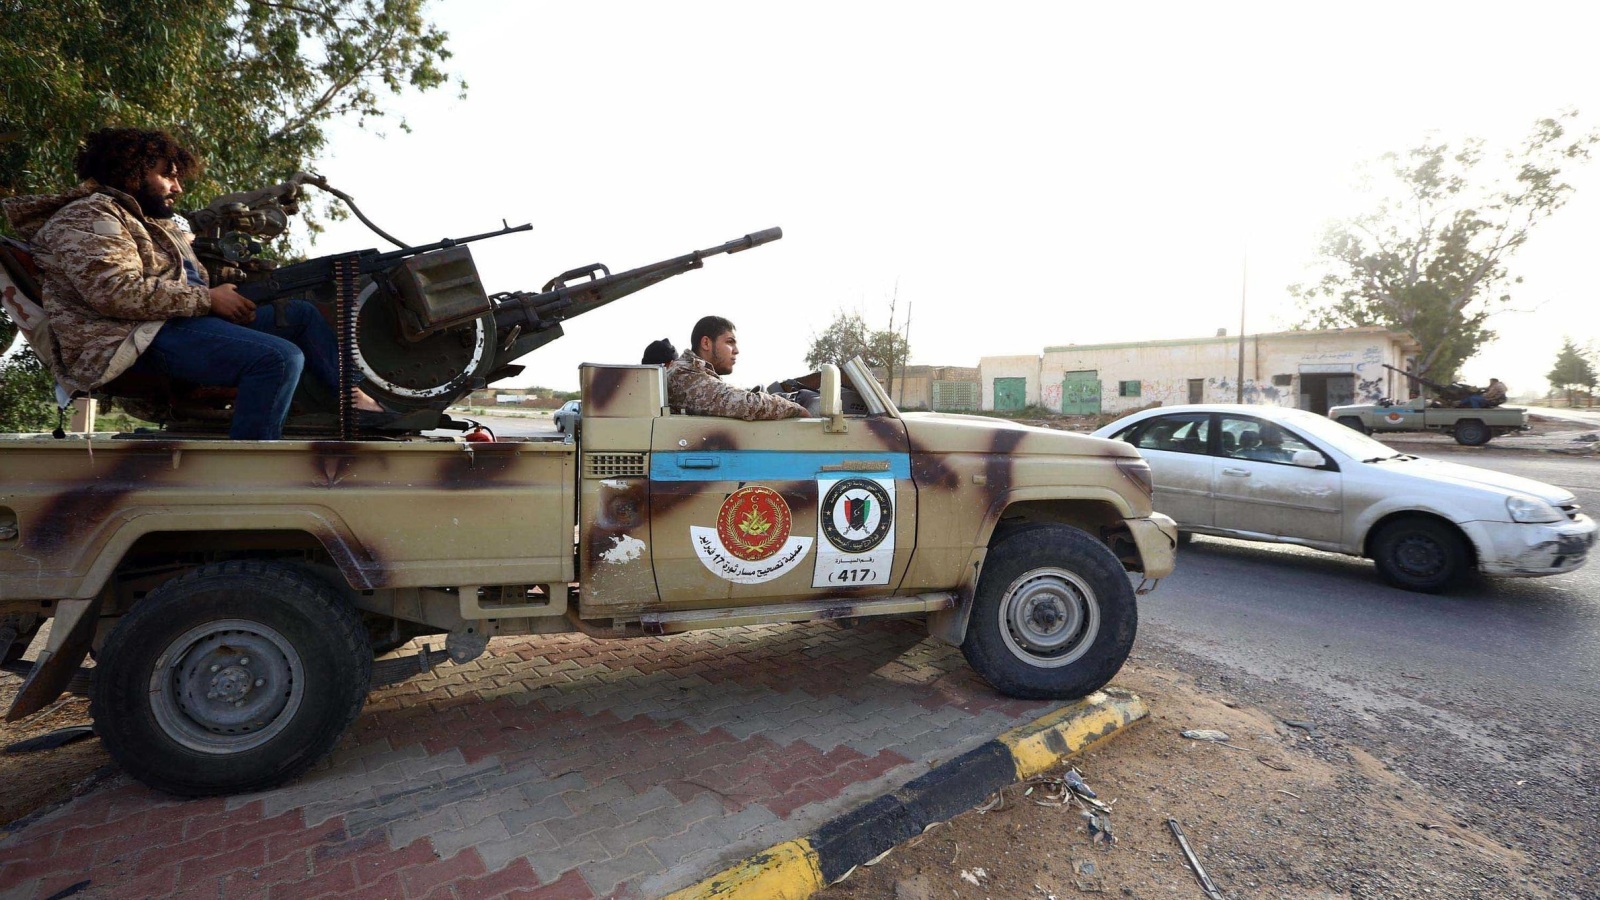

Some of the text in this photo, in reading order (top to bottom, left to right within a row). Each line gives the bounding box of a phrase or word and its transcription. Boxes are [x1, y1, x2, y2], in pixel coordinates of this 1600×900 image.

[699, 535, 717, 556] فبراير
[784, 544, 803, 563] عملية
[712, 553, 725, 565] 17
[722, 560, 739, 574] ثورة
[735, 567, 756, 577] مسار
[756, 559, 784, 577] تصحيح
